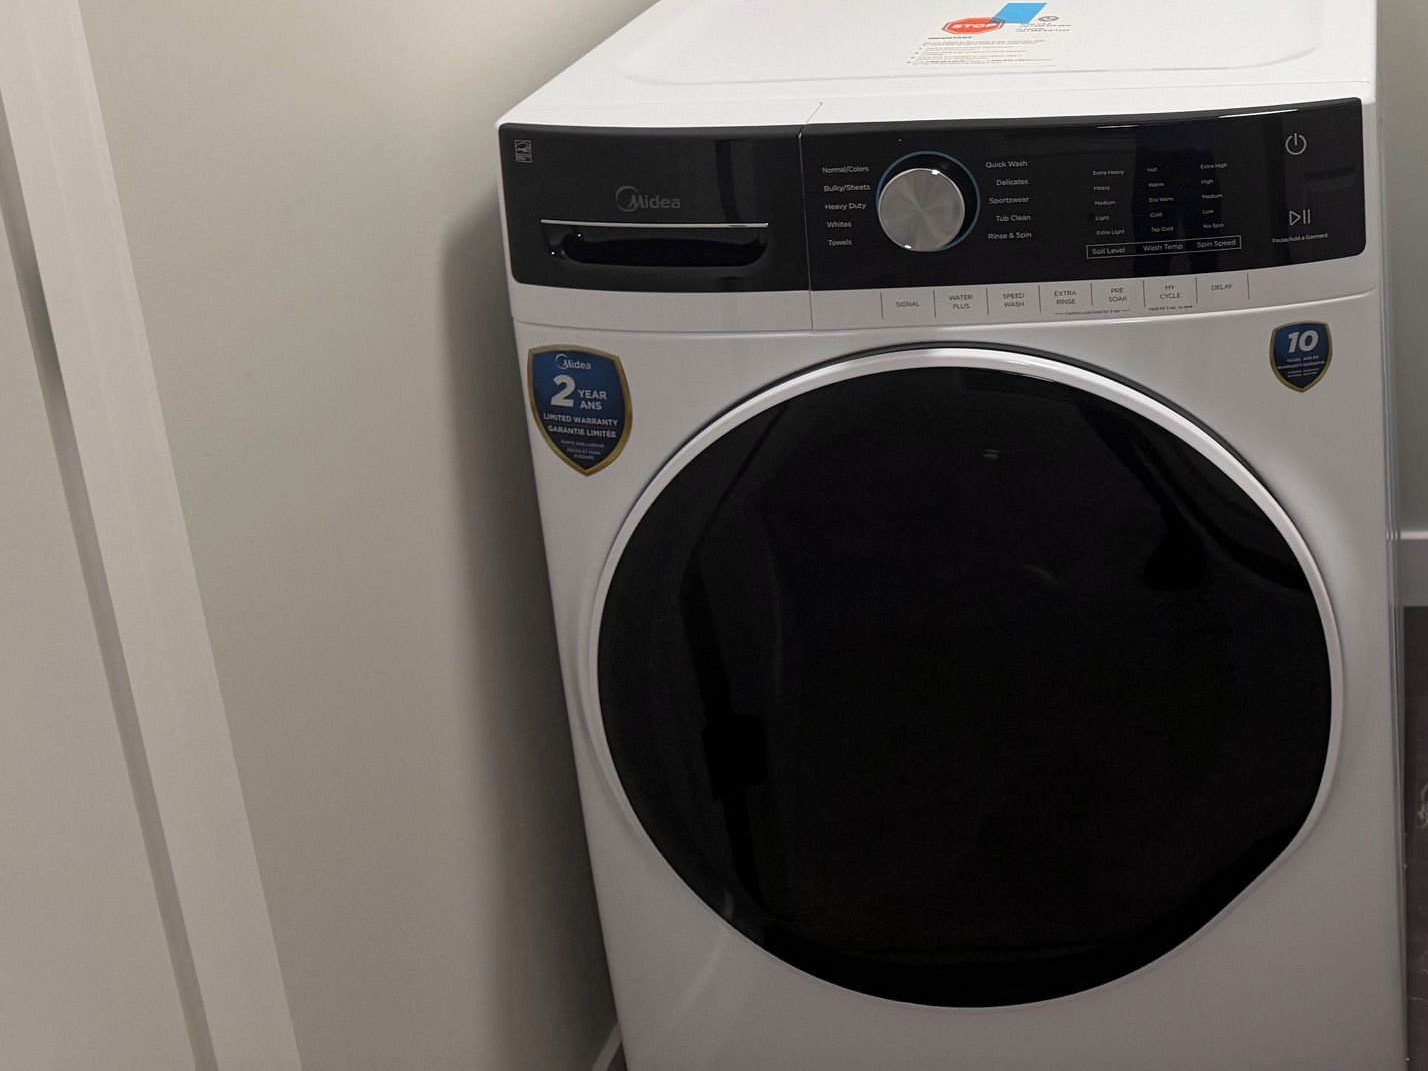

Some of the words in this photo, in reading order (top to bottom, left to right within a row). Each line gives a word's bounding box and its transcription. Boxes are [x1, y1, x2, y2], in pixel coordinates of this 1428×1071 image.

[616, 185, 680, 212] Midea
[989, 196, 1029, 204] Sportswear
[1016, 231, 1032, 239] Spin
[1163, 243, 1183, 251] Temp
[1214, 239, 1236, 247] Speed
[1289, 330, 1318, 353] 10
[555, 354, 591, 369] Midea
[550, 374, 576, 407] 2
[578, 390, 607, 399] YEAR
[580, 401, 602, 410] ANS
[544, 413, 571, 422] LIMITED
[573, 416, 618, 426] WARRANTY
[548, 425, 585, 435] GARANTIE
[587, 429, 616, 438] LIMITÉE
